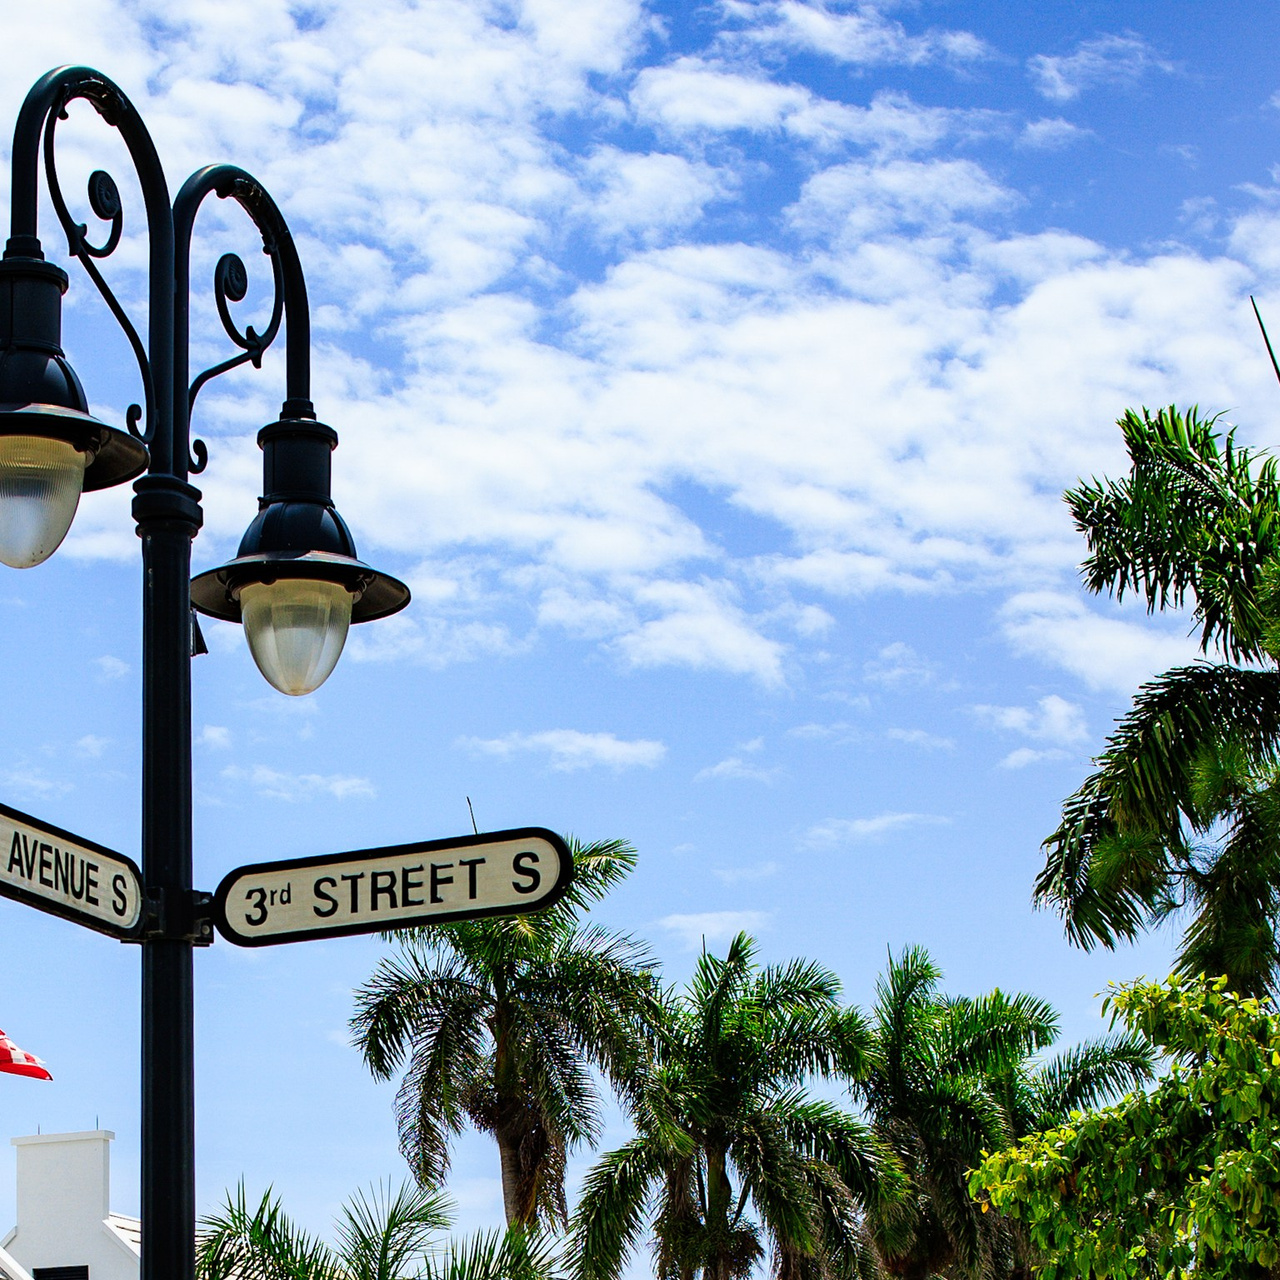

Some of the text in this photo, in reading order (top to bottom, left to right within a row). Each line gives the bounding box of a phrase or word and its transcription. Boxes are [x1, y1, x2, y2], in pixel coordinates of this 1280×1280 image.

[7, 830, 100, 907] AVENUE
[111, 873, 128, 918] S
[244, 881, 292, 927] 3rd
[511, 851, 541, 895] S
